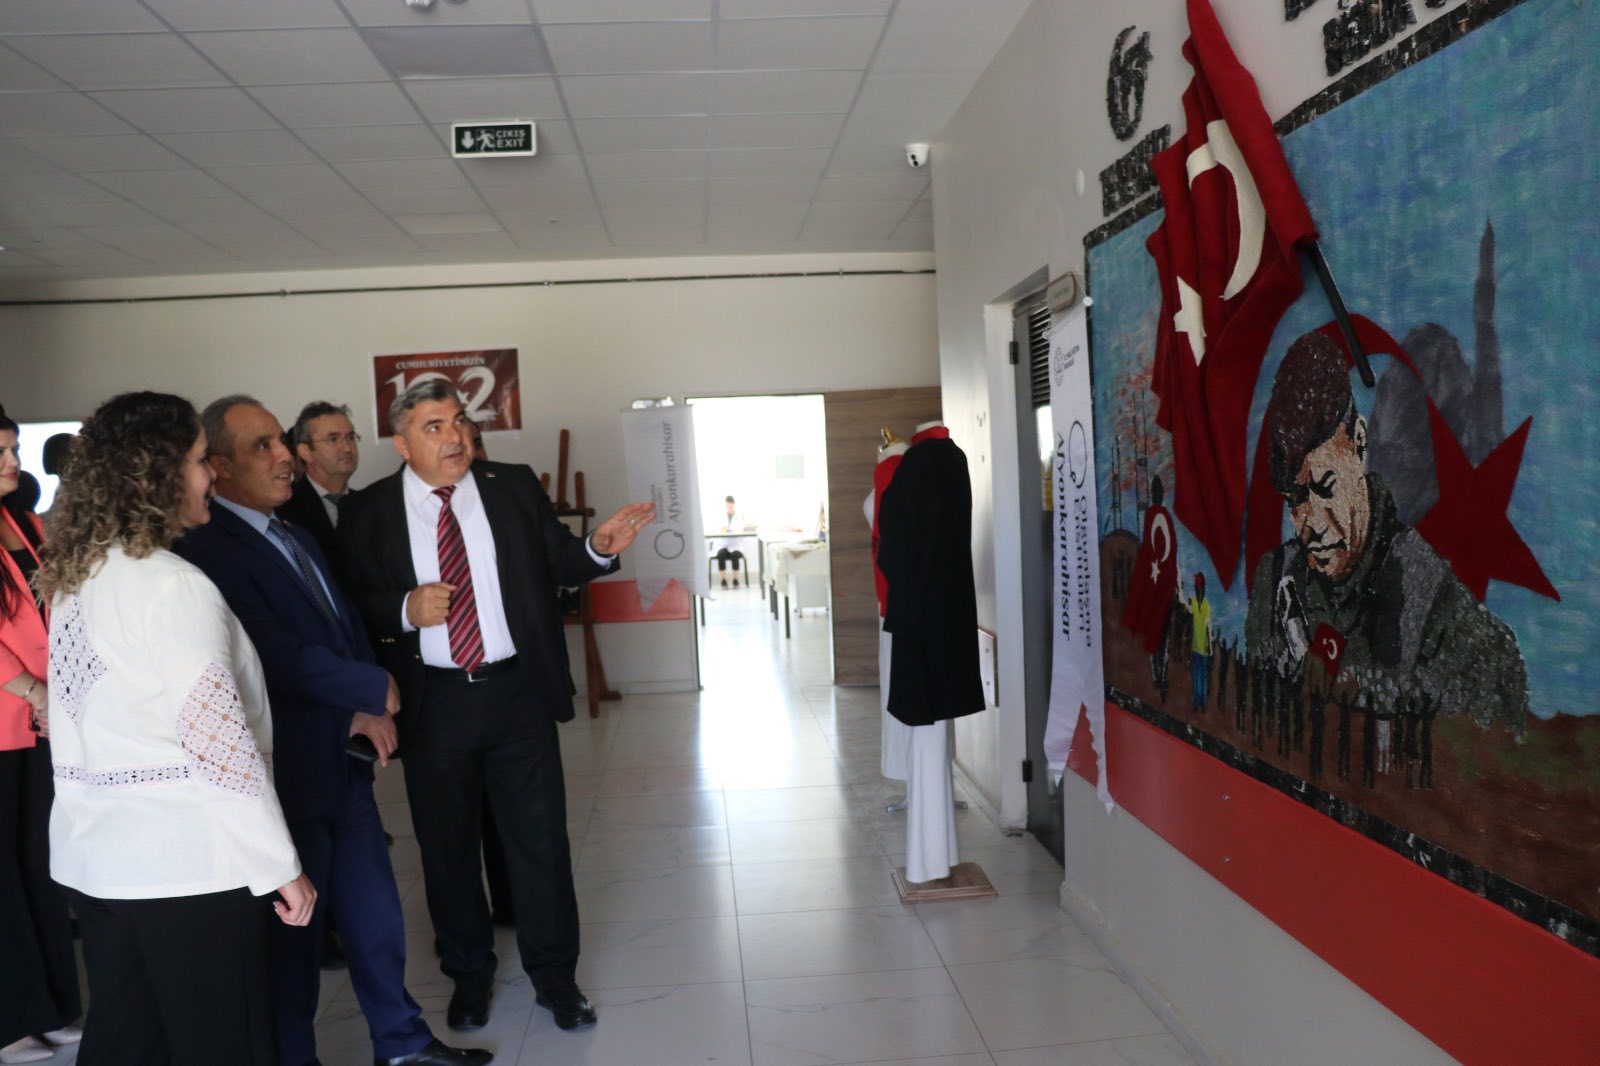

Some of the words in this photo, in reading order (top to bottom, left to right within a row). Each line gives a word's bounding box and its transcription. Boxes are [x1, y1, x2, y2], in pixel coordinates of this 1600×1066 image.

[497, 138, 524, 148] EXIT
[662, 421, 681, 521] Afyonkarahisar
[1057, 432, 1070, 642] Afyonkarahisar
[1080, 496, 1091, 647] Olgunlaşma
